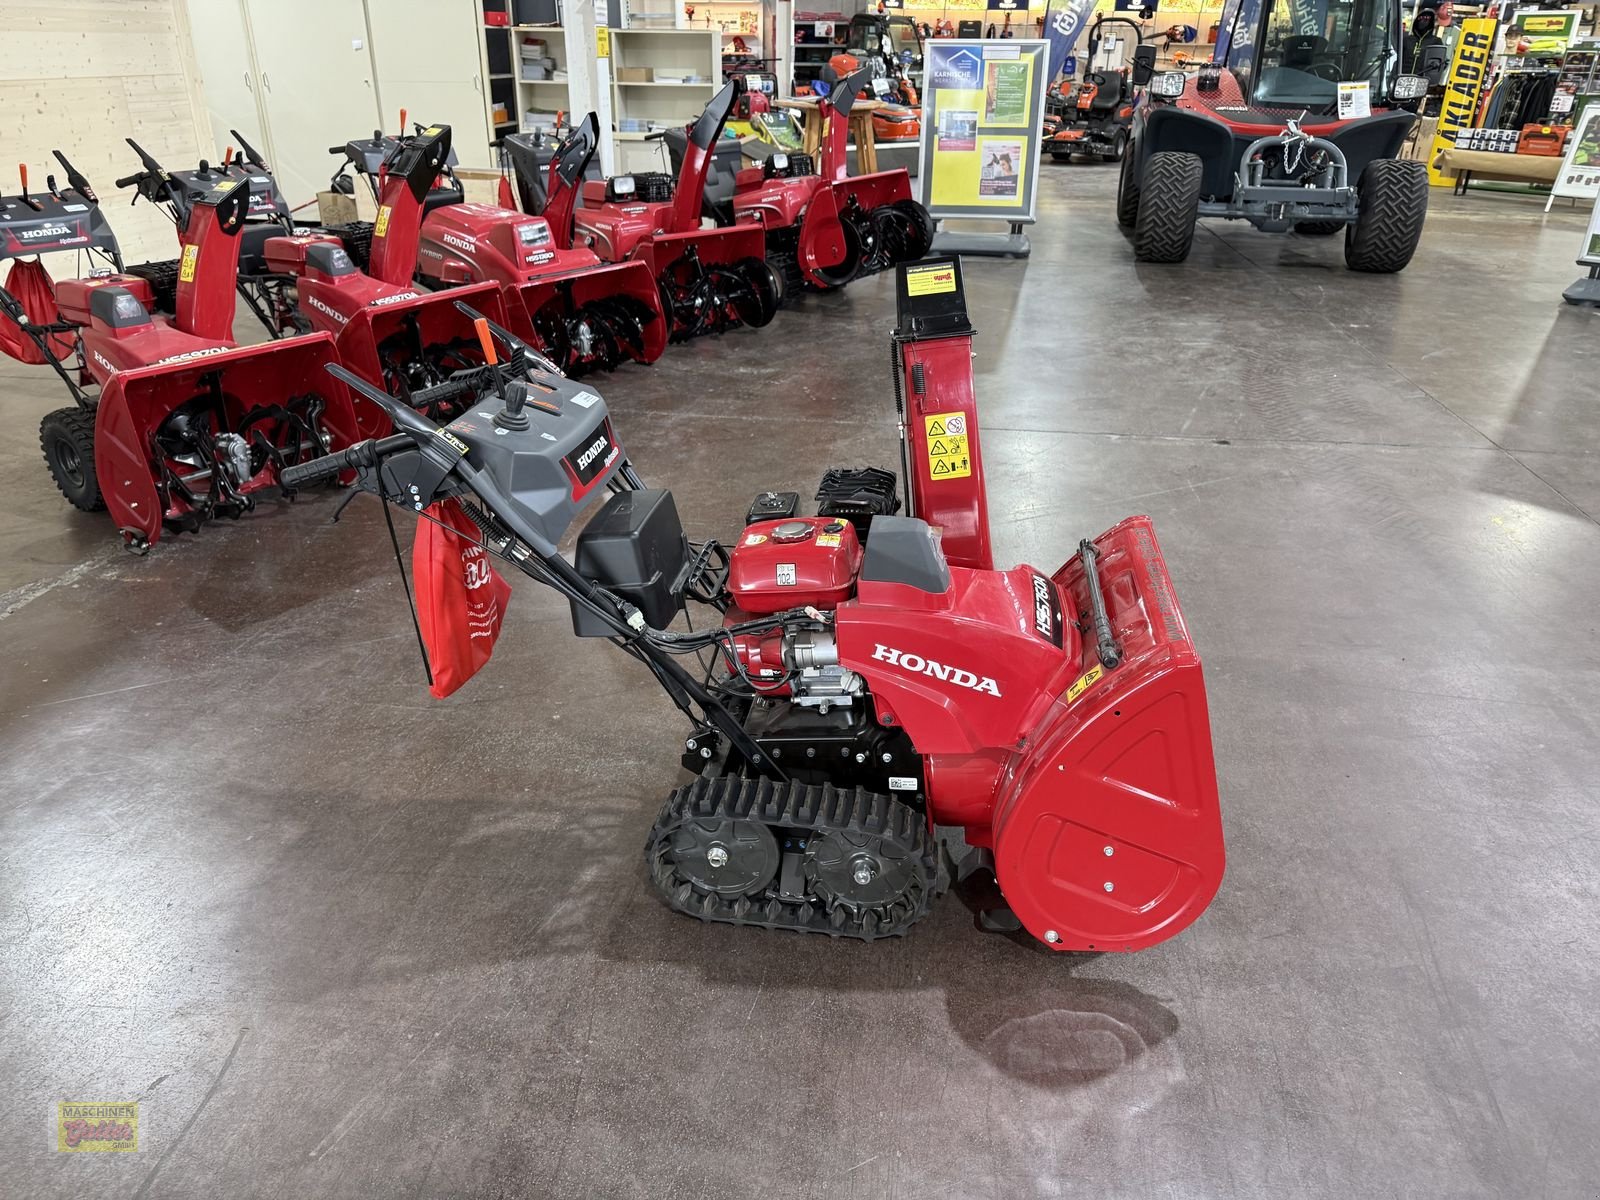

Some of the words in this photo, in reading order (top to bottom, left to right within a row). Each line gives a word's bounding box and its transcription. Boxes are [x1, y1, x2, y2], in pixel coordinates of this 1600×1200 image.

[934, 70, 972, 78] KARNISCHE
[22, 226, 71, 239] HONDA
[443, 233, 476, 254] HONDA
[421, 247, 443, 261] HYBRID
[577, 435, 608, 471] HONDA
[778, 573, 791, 584] 102
[1032, 574, 1052, 637] HSS760A
[871, 643, 1002, 697] HONDA
